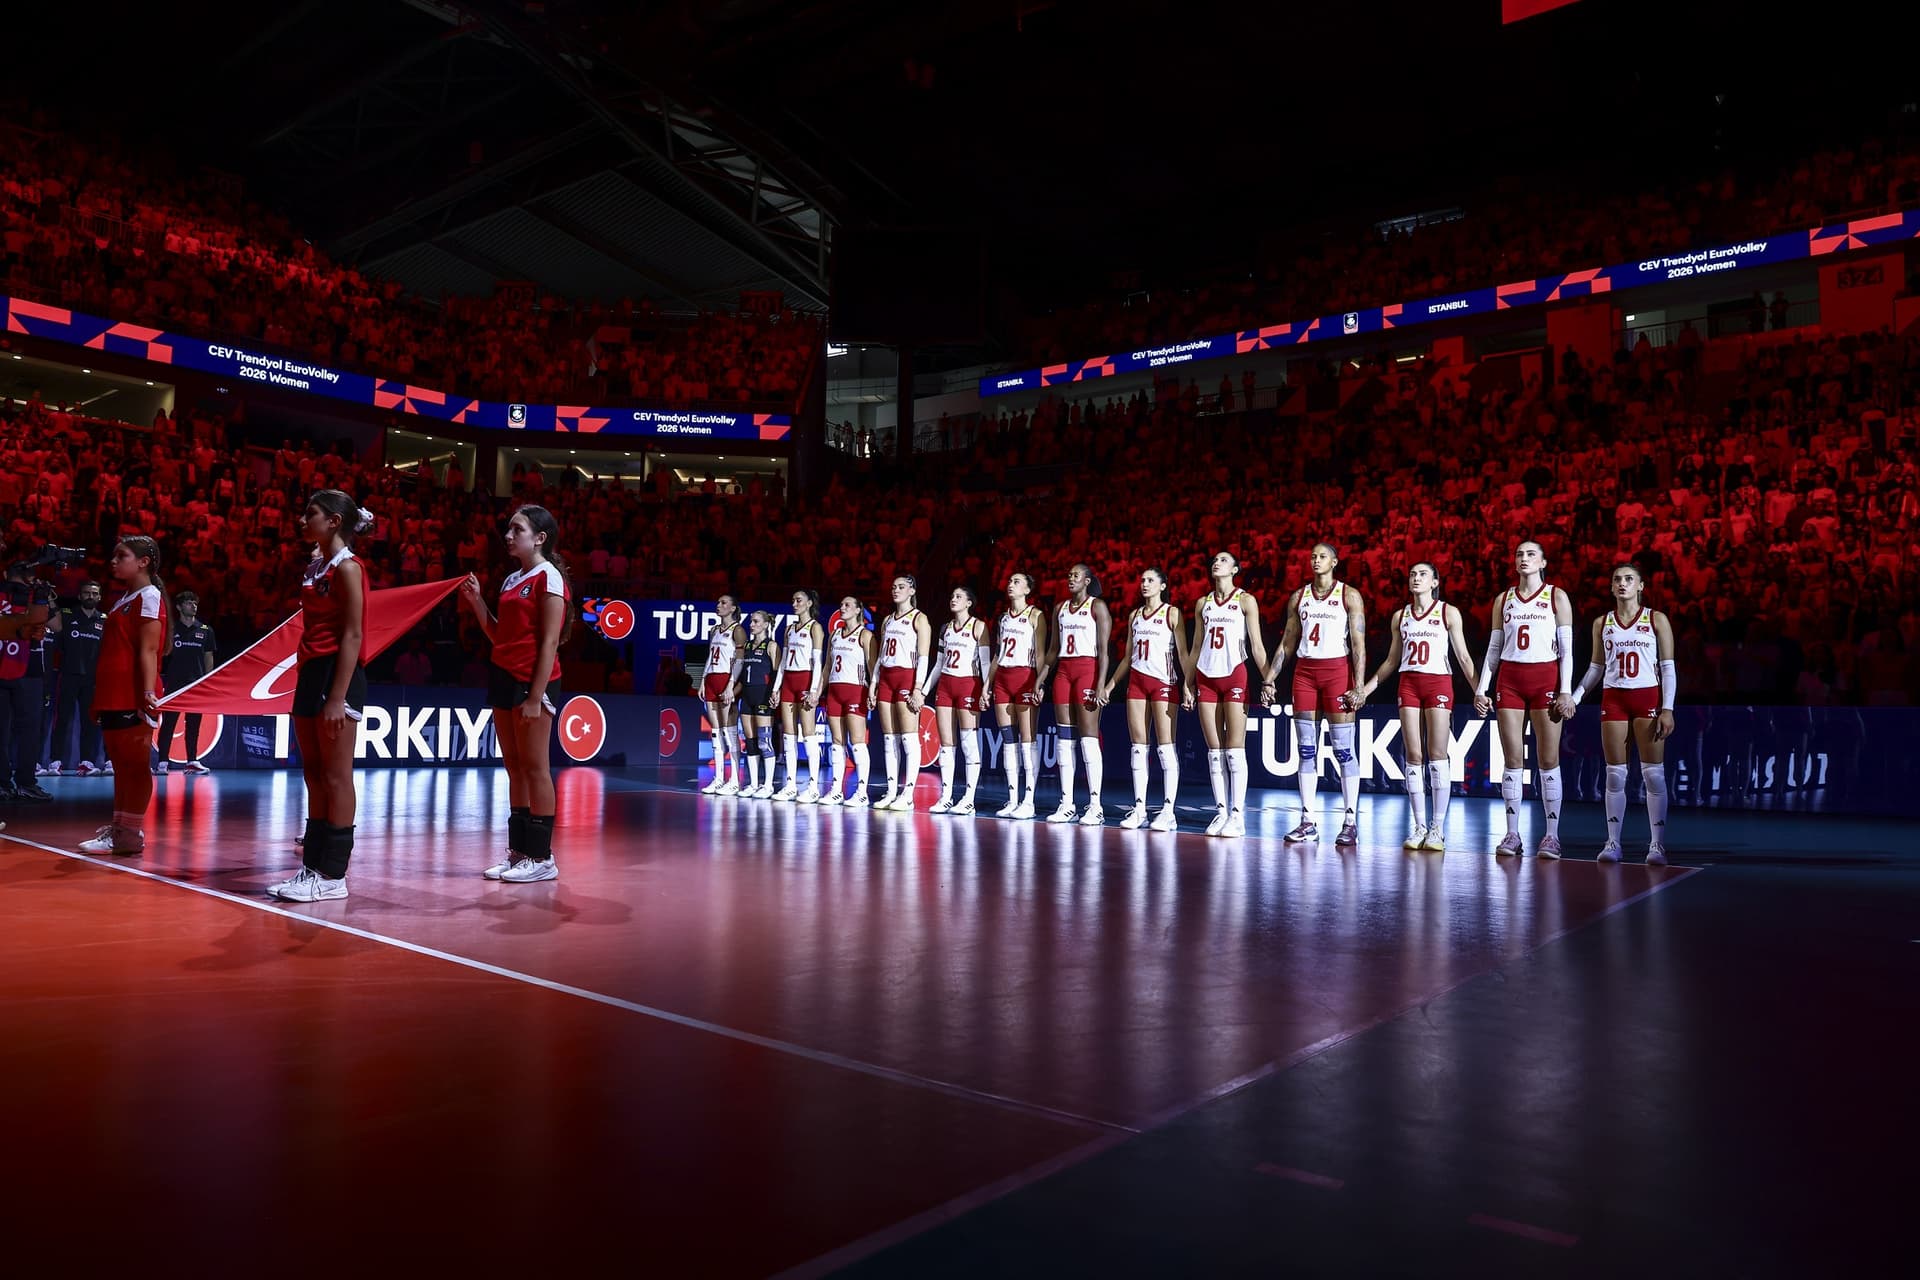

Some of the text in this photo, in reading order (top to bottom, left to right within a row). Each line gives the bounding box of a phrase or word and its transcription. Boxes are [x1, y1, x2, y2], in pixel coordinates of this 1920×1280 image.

[1638, 242, 1767, 272] CEV Trendyol EuroVolley
[1667, 260, 1736, 279] 2026 Women
[1428, 299, 1469, 314] ISTANBUL
[1132, 340, 1211, 360] CEV Trendyol EuroVolley
[208, 345, 340, 383] CEV Trendyol EuroVolley
[1150, 354, 1193, 367] 2026 Women
[239, 366, 310, 390] 2026 Women
[997, 377, 1024, 388] ISTANBUL
[633, 412, 736, 426] CEV Trendyol EuroVolley
[657, 424, 712, 435] 2026 Women
[1209, 626, 1224, 650] 15
[1309, 623, 1320, 647] 4
[1408, 630, 1439, 638] vodafone
[1517, 624, 1530, 651] 6
[1615, 640, 1650, 648] vodafone
[711, 645, 720, 662] 14
[885, 637, 897, 657] 18
[1002, 637, 1016, 658] 12
[1067, 634, 1075, 655] 8
[1137, 639, 1150, 661] 11
[1408, 641, 1430, 665] 20
[789, 649, 796, 667] 7
[835, 654, 842, 673] 3
[946, 649, 960, 669] 22
[1616, 651, 1639, 678] 10
[746, 665, 752, 683] 1
